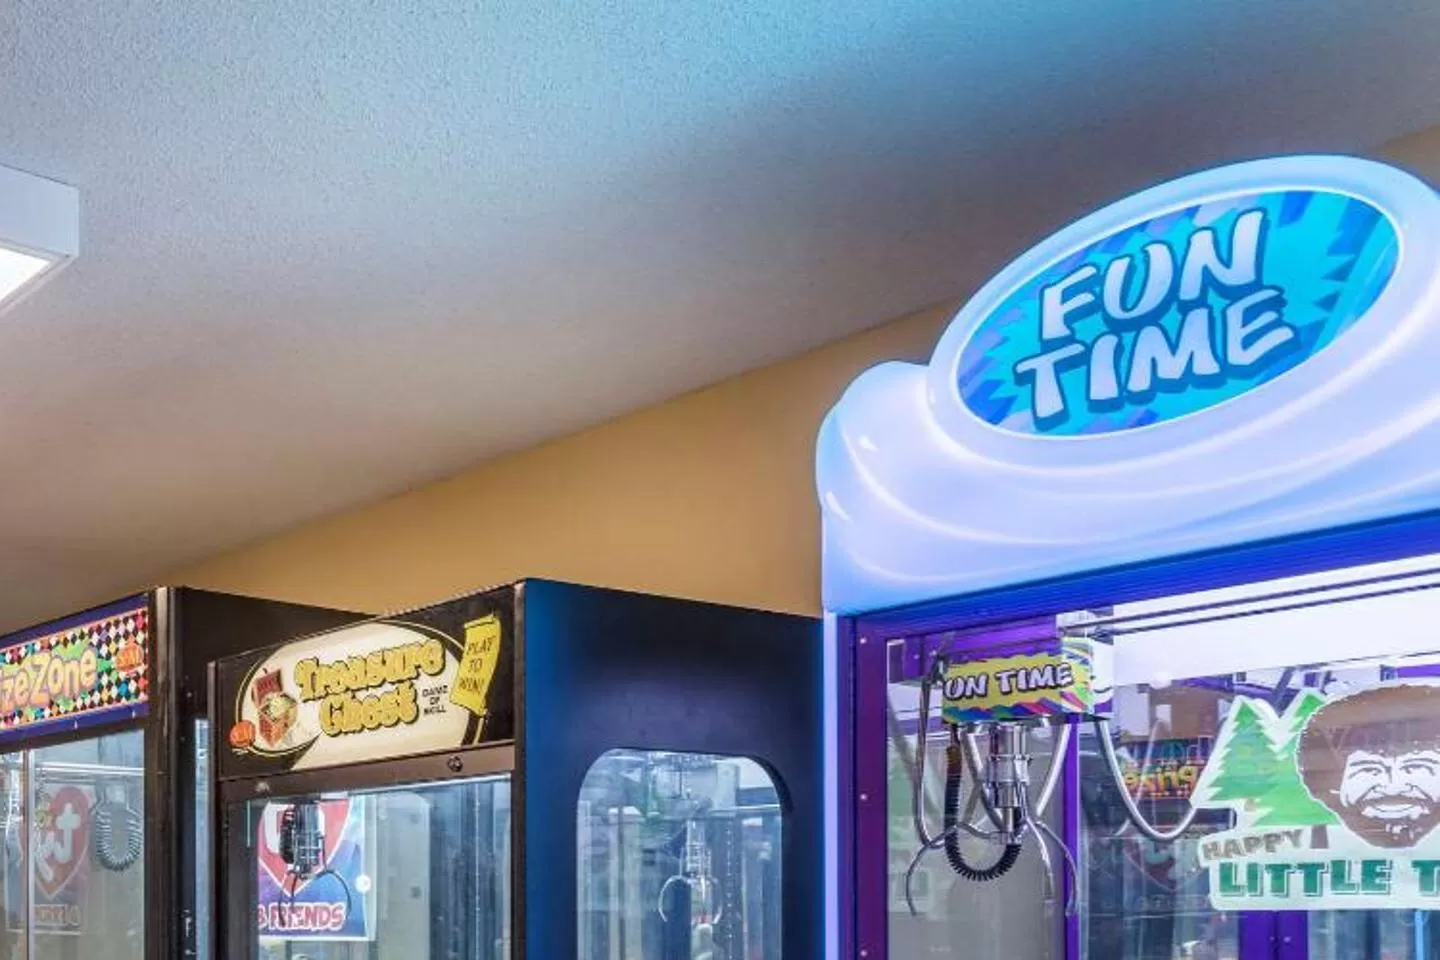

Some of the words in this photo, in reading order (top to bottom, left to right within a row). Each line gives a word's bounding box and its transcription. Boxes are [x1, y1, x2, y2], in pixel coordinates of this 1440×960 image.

[1039, 208, 1266, 342] FUN
[1014, 296, 1297, 422] TIME
[944, 672, 989, 700] UN
[994, 662, 1073, 695] TIME
[320, 681, 419, 737] Chest
[1202, 829, 1305, 859] HAPPY
[1219, 860, 1393, 898] LITTLE
